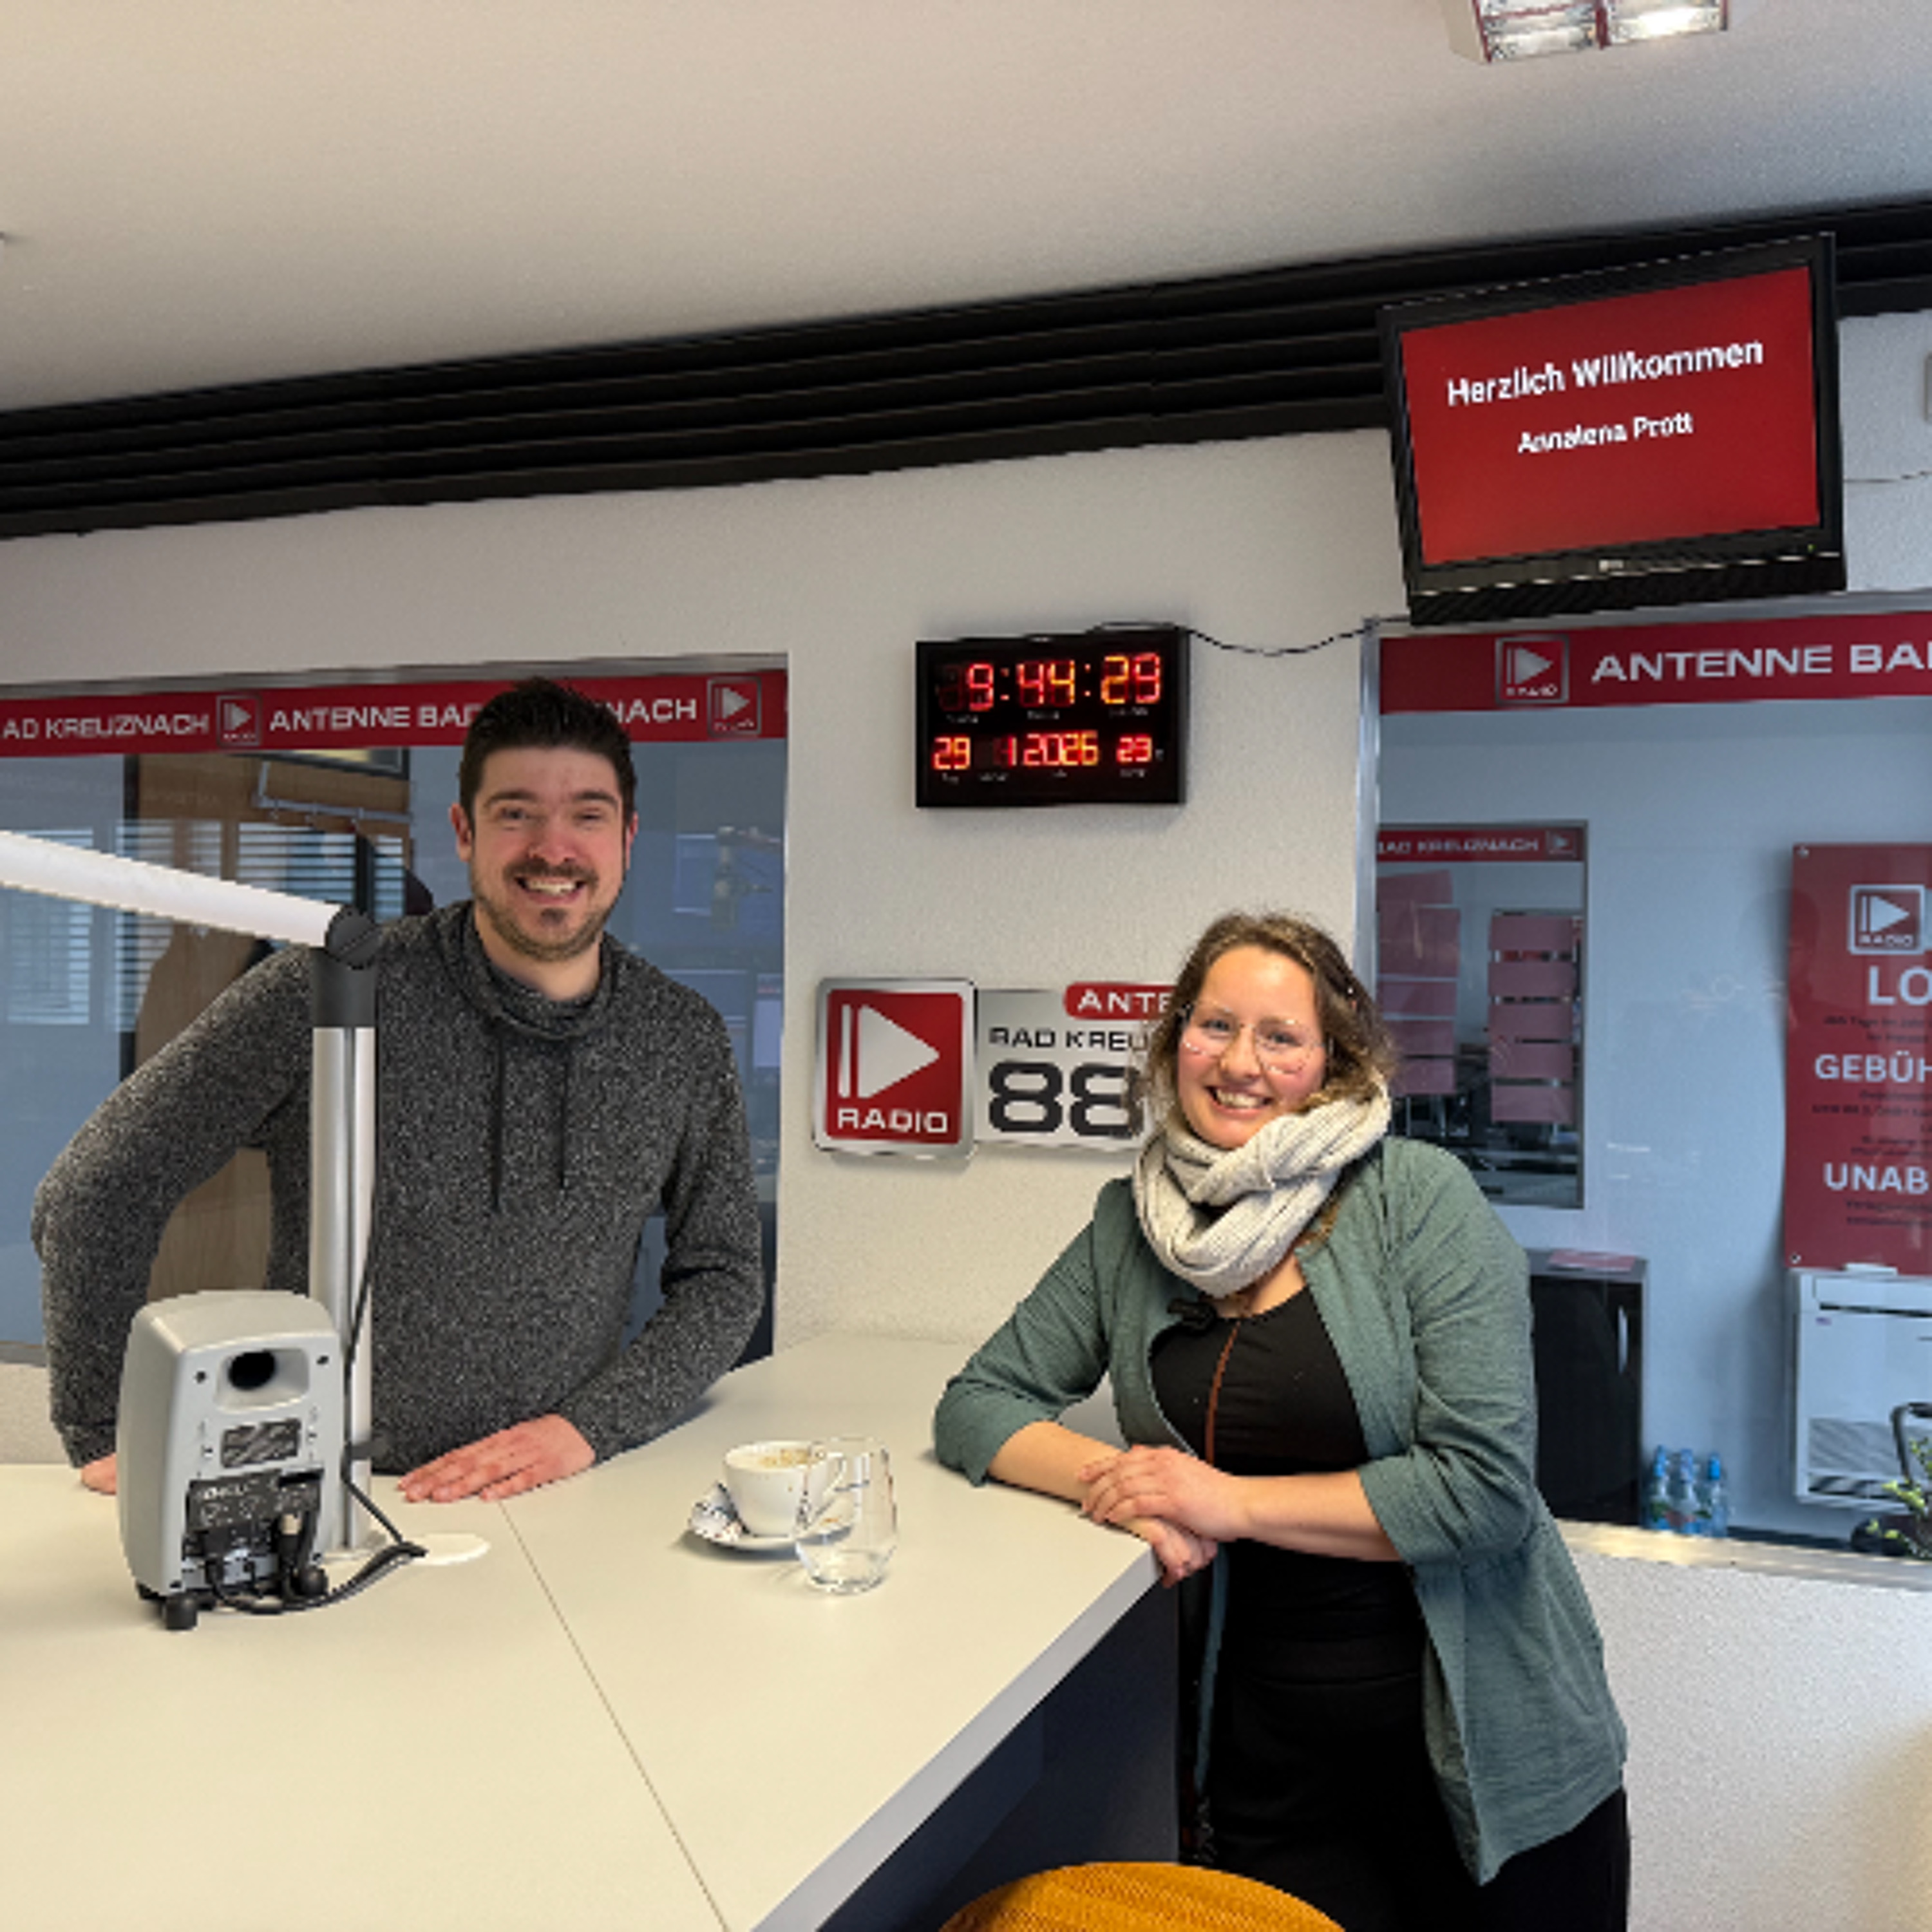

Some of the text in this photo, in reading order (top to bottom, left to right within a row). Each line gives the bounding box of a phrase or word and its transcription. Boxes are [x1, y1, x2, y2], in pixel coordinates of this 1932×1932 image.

[1448, 340, 1763, 406] Herzlich Willkommen
[1517, 412, 1693, 453] Annalena Prott
[1591, 641, 1932, 685] ANTENNE BA
[45, 714, 209, 739] KREUZNACH
[269, 706, 410, 732] ANTENNE
[933, 736, 971, 770] 29
[1117, 736, 1152, 762] 23
[837, 1107, 947, 1133] RADIO
[1824, 1162, 1929, 1195] UNAB
